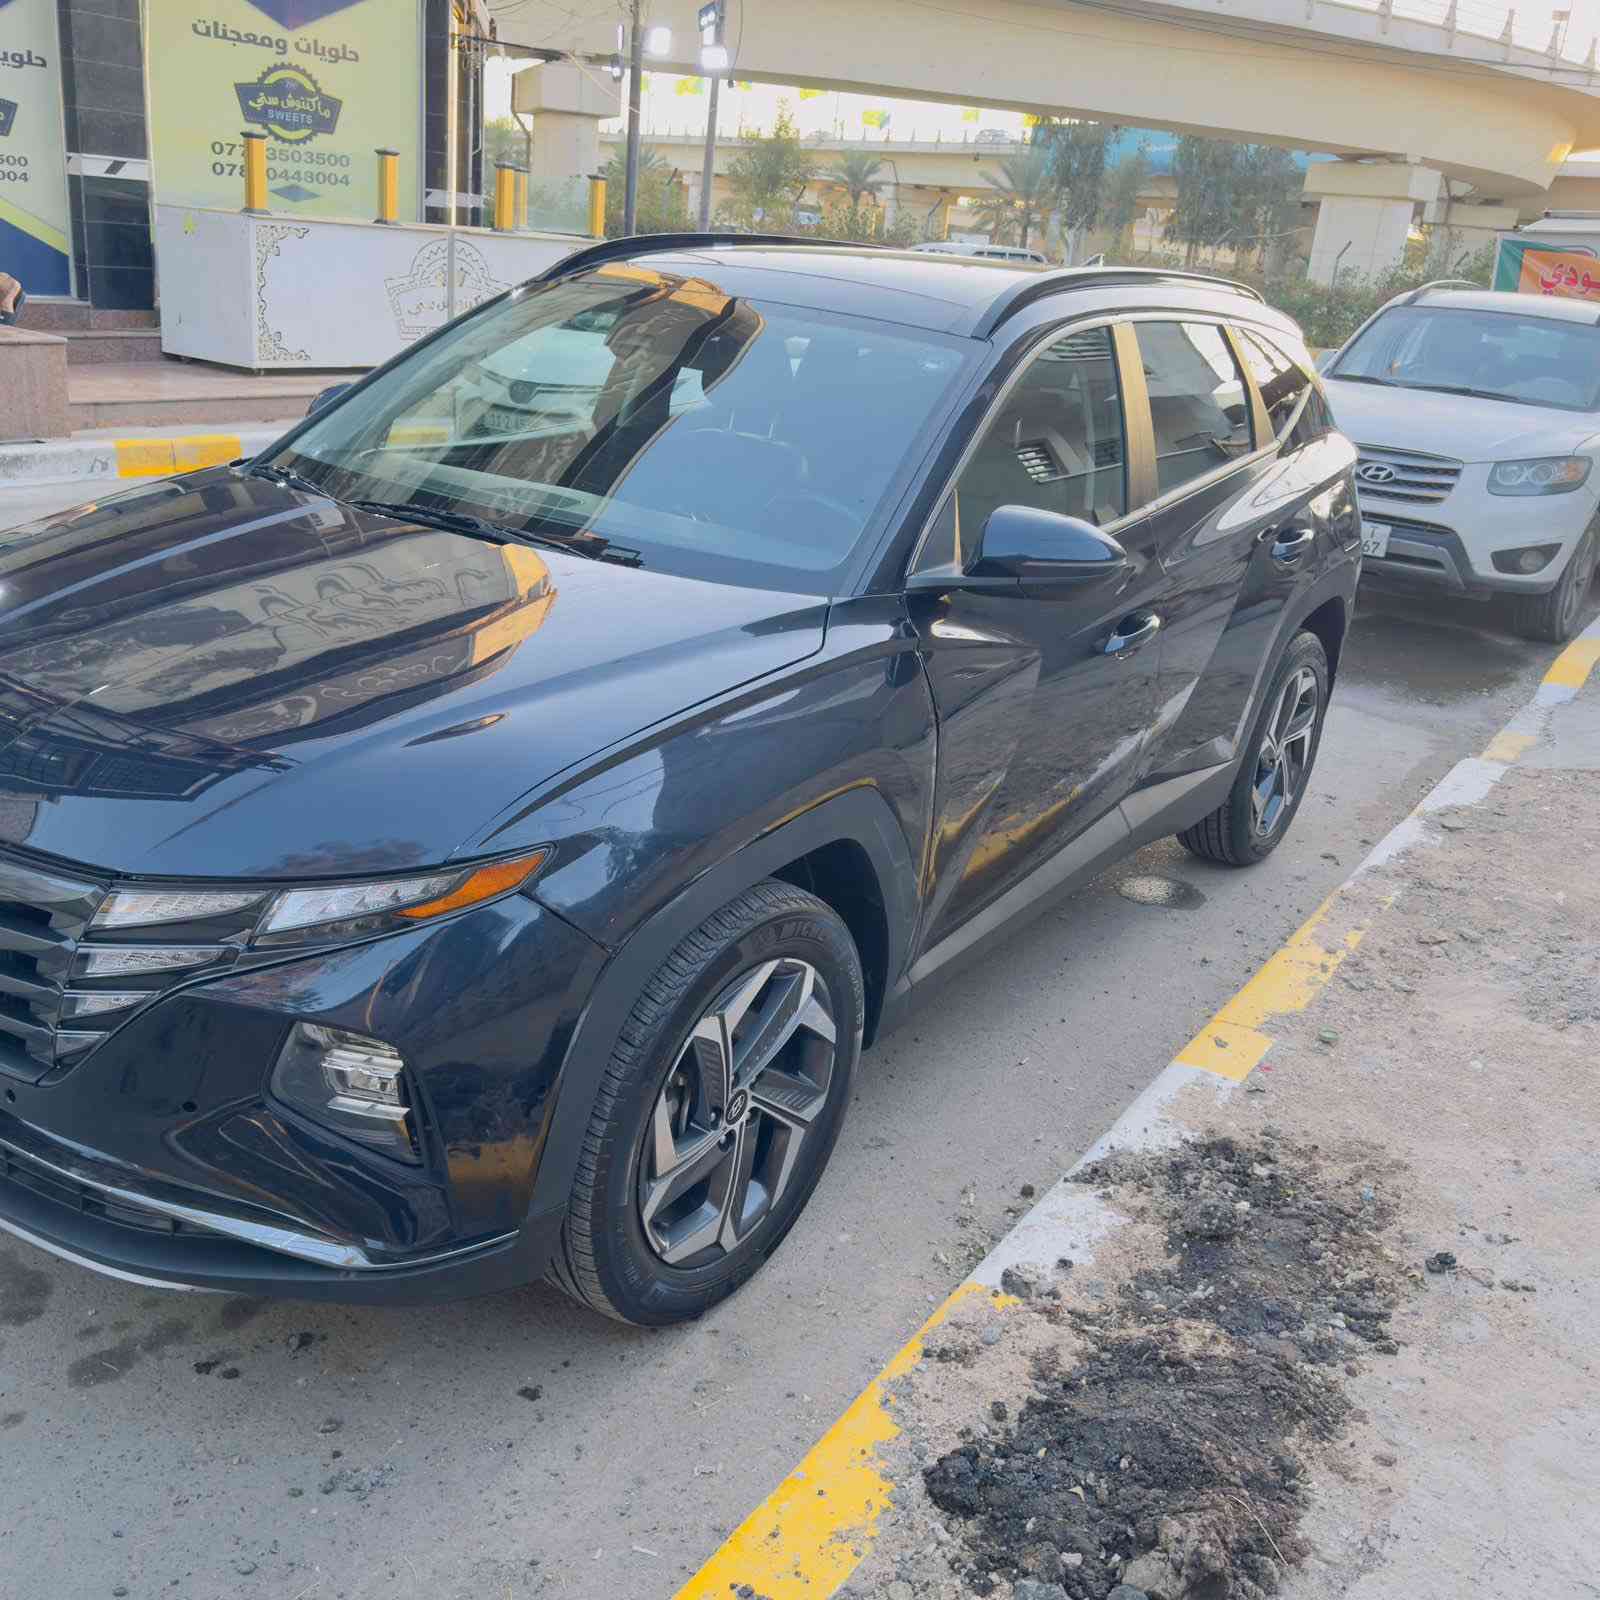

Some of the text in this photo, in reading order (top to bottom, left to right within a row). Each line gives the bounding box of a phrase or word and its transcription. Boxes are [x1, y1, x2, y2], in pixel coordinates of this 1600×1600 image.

[191, 19, 360, 63] حلويات ومعجنات
[267, 109, 313, 124] SWEETS
